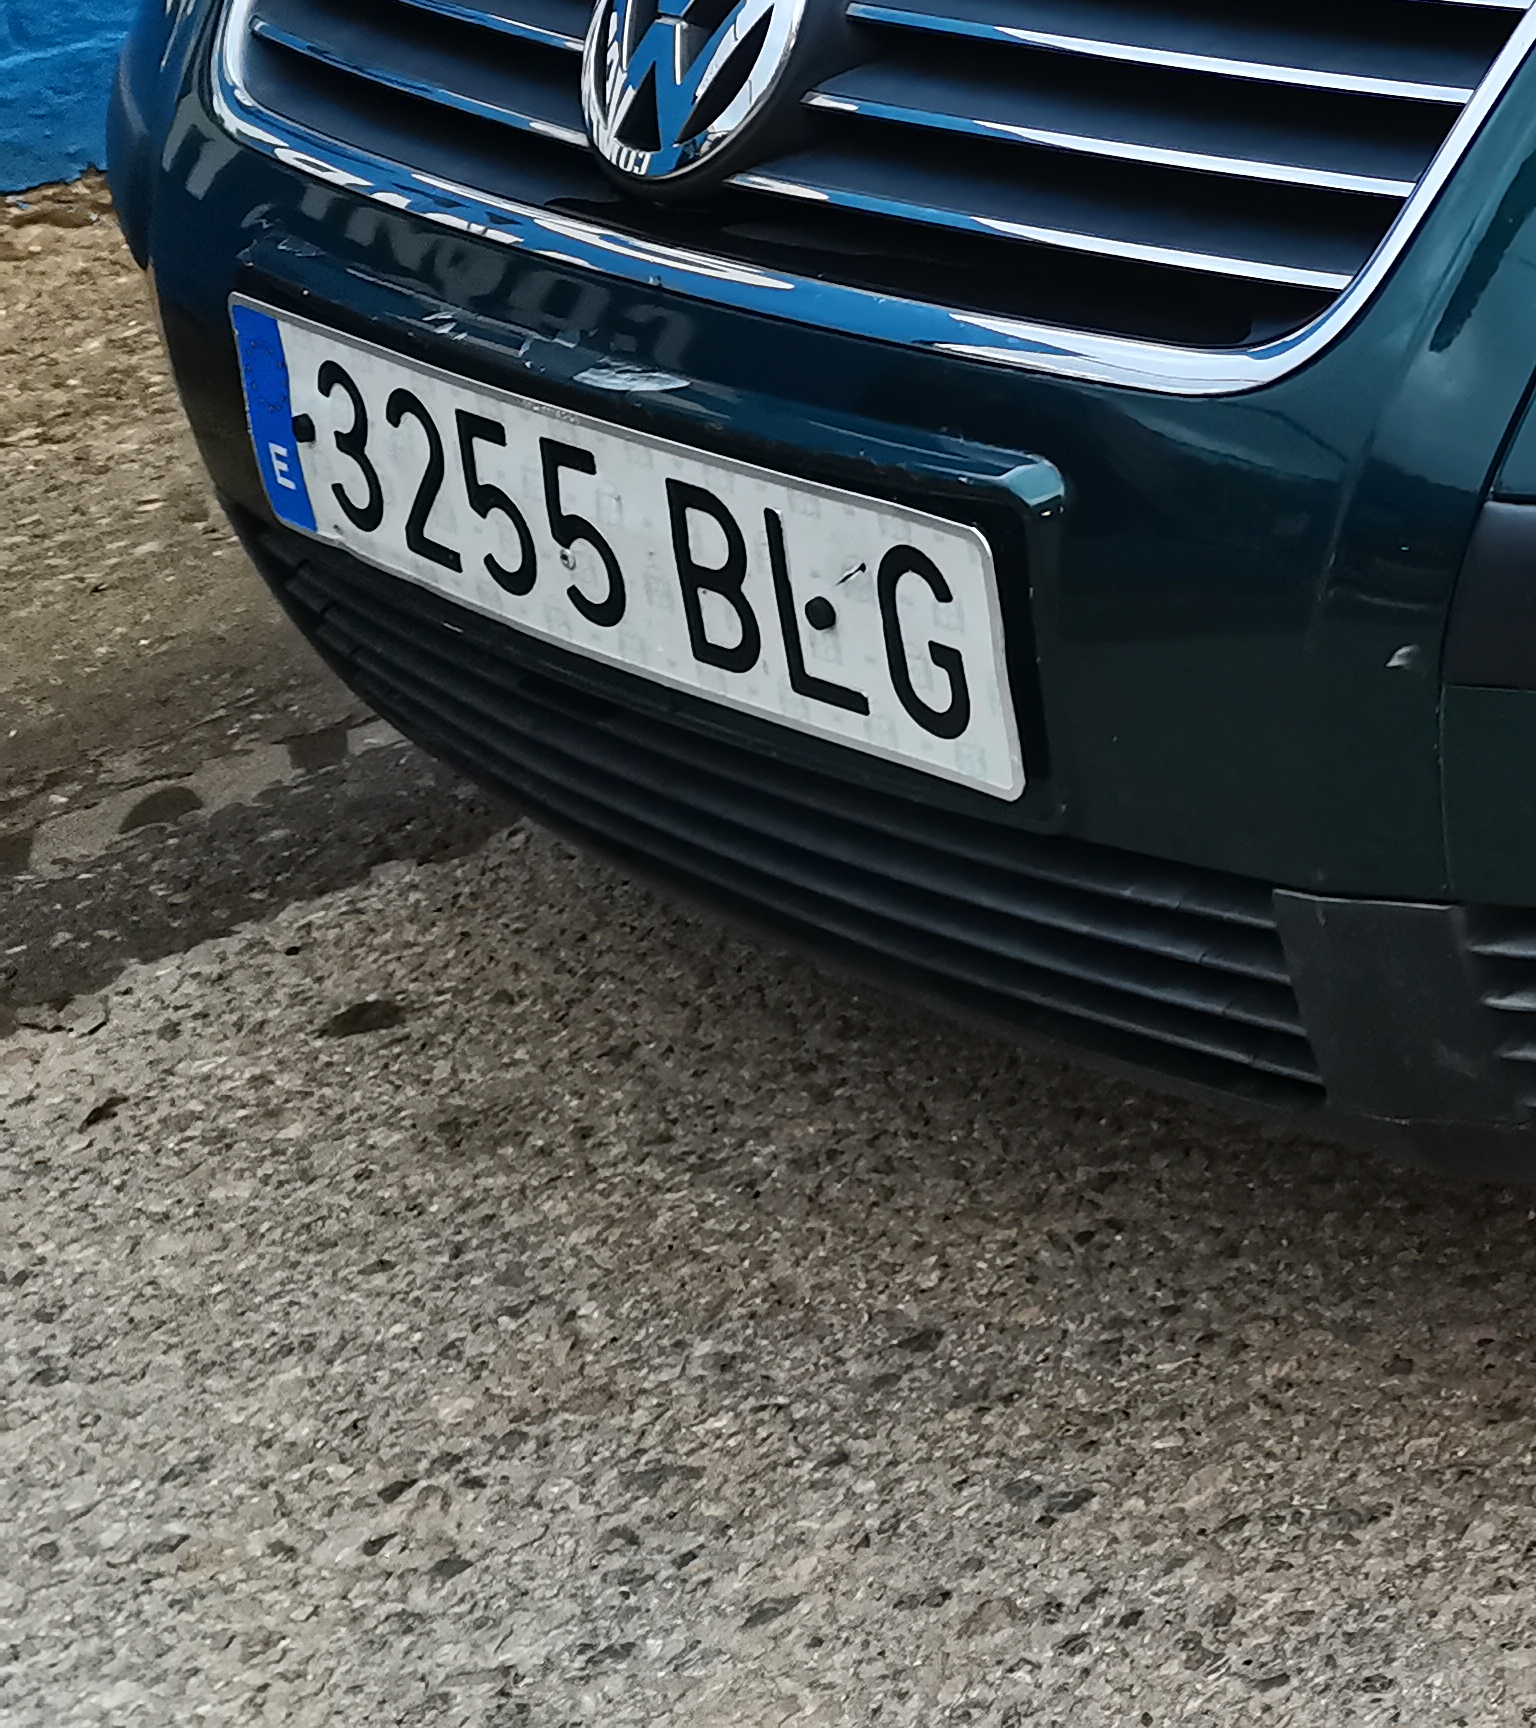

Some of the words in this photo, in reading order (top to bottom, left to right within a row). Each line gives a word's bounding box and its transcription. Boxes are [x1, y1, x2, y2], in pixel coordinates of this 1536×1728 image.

[256, 442, 297, 491] E
[316, 359, 626, 628] 3255
[665, 477, 971, 740] BLG
